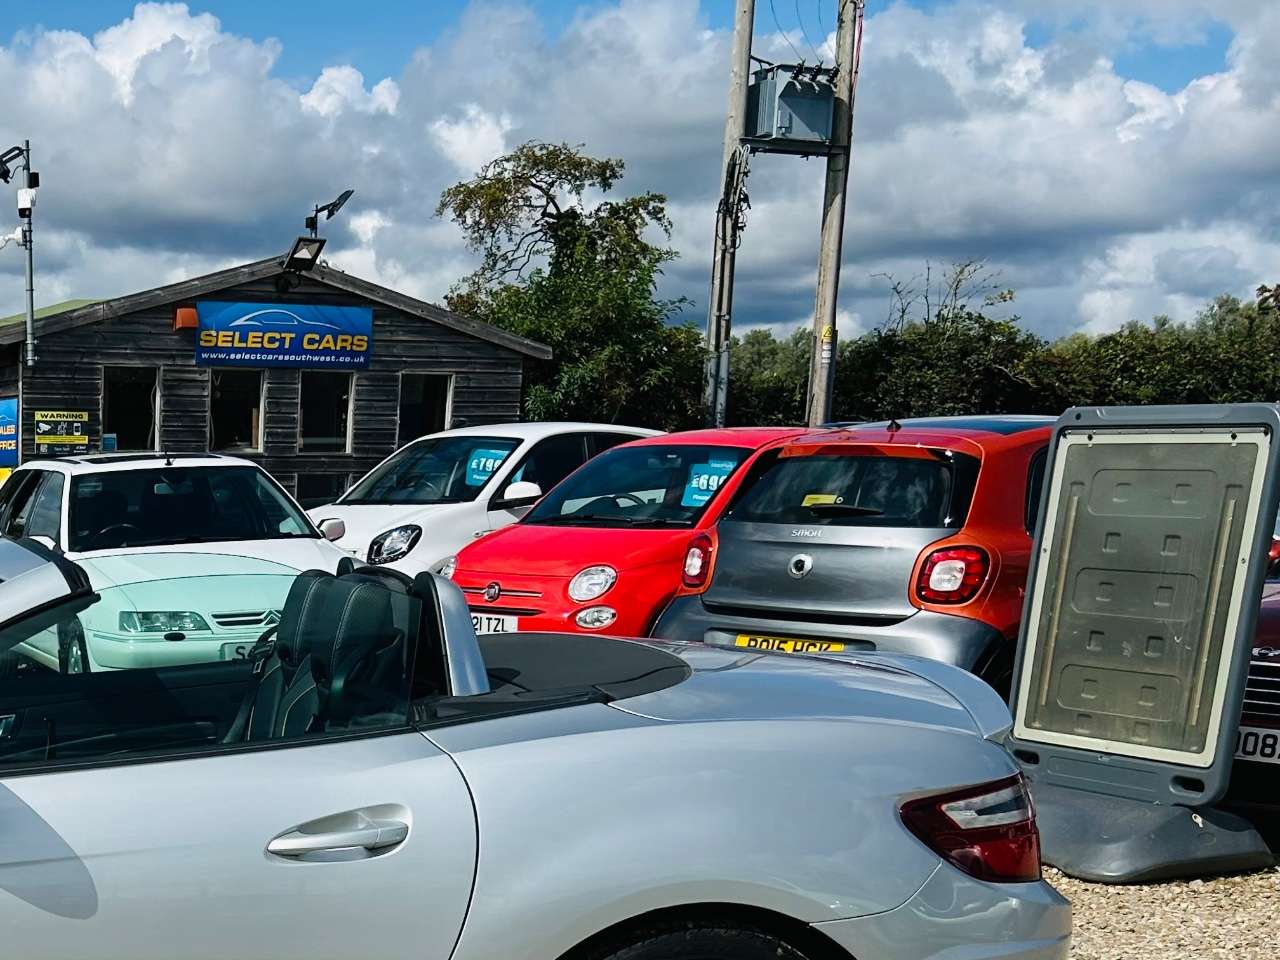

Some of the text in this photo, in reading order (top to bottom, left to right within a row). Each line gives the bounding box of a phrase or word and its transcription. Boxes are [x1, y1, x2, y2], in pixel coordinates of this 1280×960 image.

[199, 330, 369, 351] SELECT CARS
[201, 352, 365, 363] www.selectcarssouthwest.co.uk
[40, 412, 84, 420] WARNING
[485, 617, 509, 632] TZL
